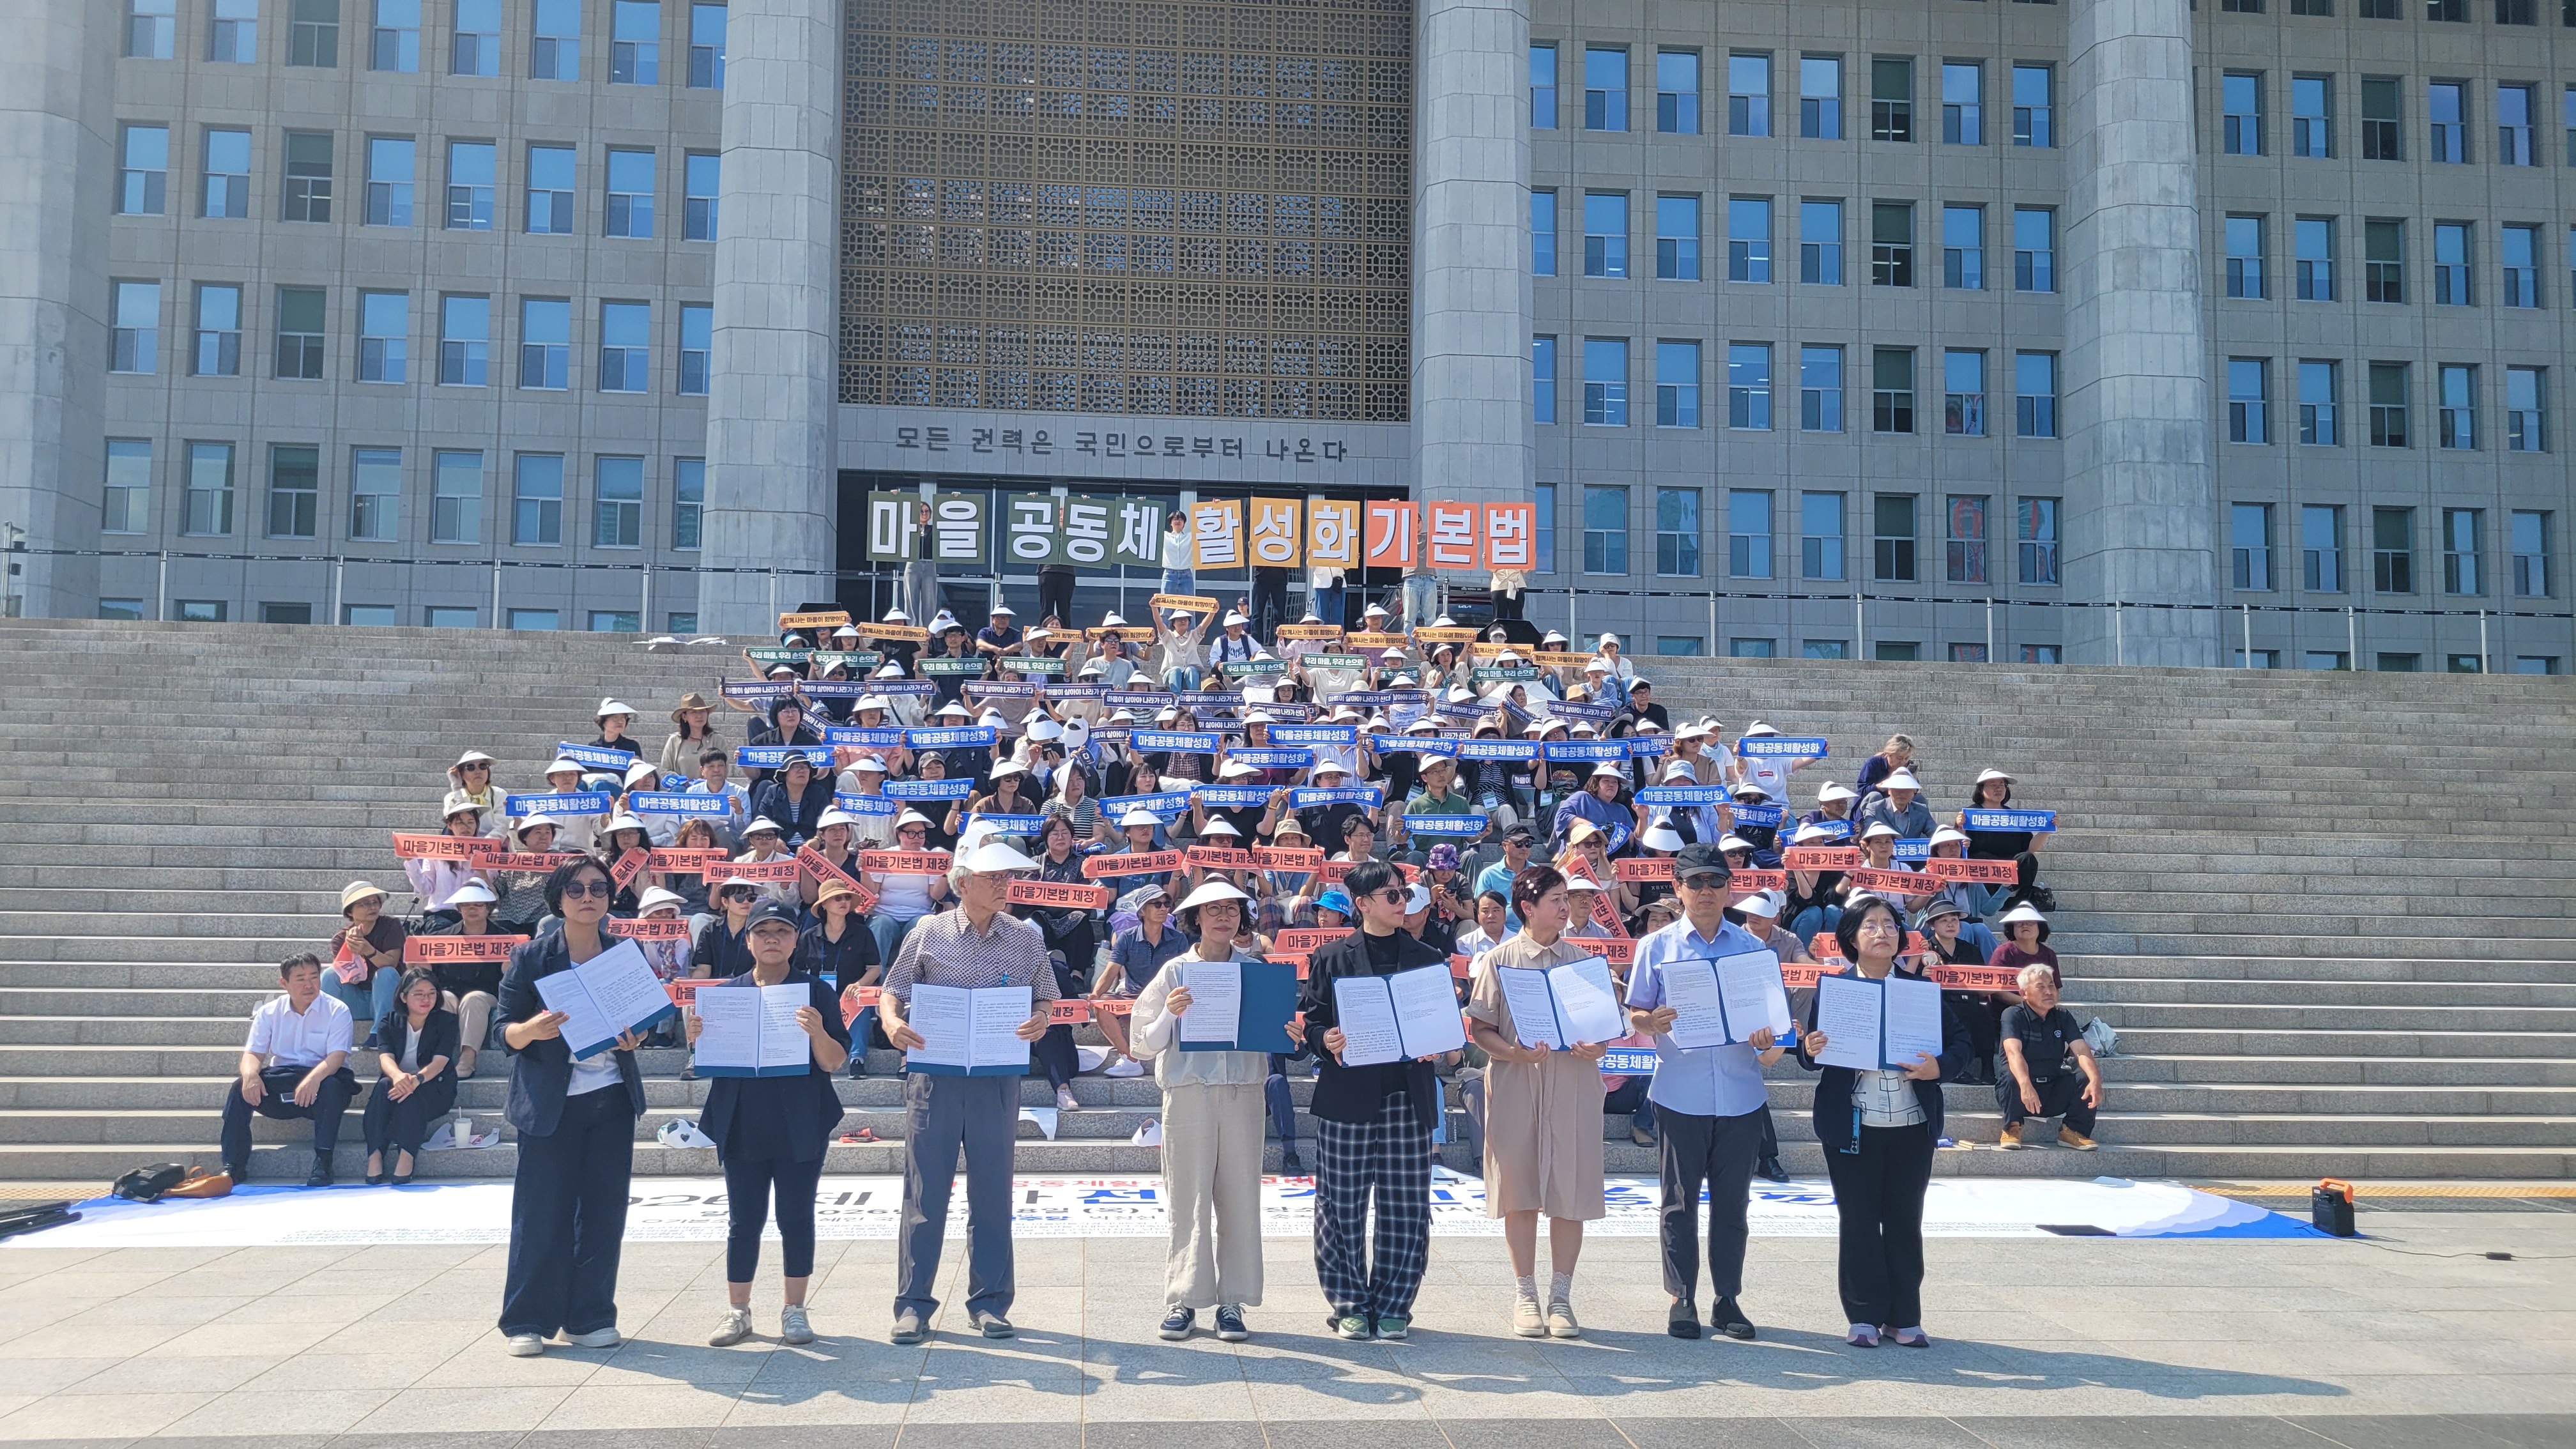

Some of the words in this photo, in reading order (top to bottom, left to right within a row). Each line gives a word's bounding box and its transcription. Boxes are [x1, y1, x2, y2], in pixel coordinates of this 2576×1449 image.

[896, 426, 949, 451] 모든
[971, 427, 1052, 454] 권력은
[1075, 431, 1243, 459] 국민으로부터
[1266, 437, 1347, 462] 나온다
[871, 500, 980, 559] 마을
[1011, 501, 1159, 563] 공동체
[1194, 504, 1359, 565] 활성화
[1370, 507, 1528, 565] 기본법
[833, 731, 899, 744] 마을공동체활성
[912, 730, 988, 744] 마을공동체활성화
[1276, 728, 1349, 740] 마을공동체활성화
[1138, 734, 1211, 749] 마을공동체활성화
[1380, 740, 1452, 752] 마을공동체활성화
[1463, 744, 1534, 755] 마을공동체활성화
[1550, 747, 1621, 757] 마을공동체활성화
[1747, 742, 1819, 754] 마을공동체활성화
[1234, 753, 1306, 763] 마을공동체활성화
[887, 783, 970, 795] 마을공동체활성화
[1298, 791, 1374, 802] 마을공동체활성화
[1644, 790, 1723, 802] 마을공동체활성화
[516, 797, 601, 811] 마을공동체활성화
[639, 797, 721, 811] 마을공동체활성화
[1406, 819, 1483, 831] 마을공동체활성화
[1972, 814, 2047, 827] 마을공동체활성화
[1629, 864, 1676, 875] 마을기본
